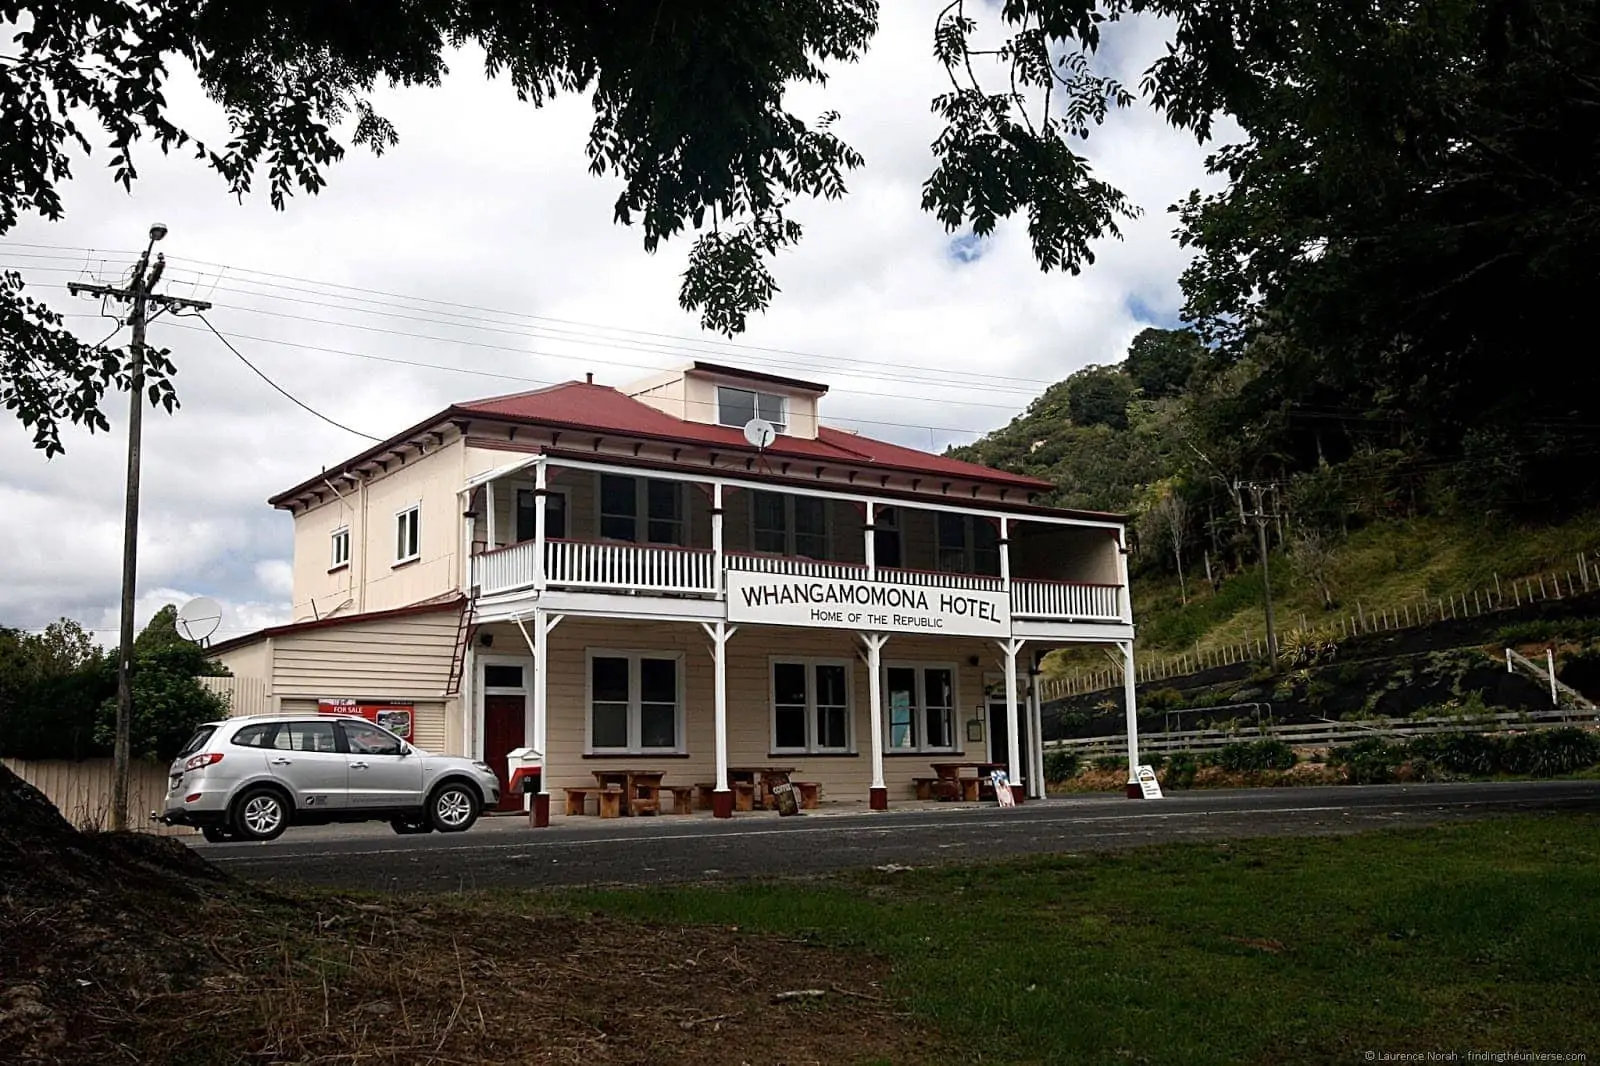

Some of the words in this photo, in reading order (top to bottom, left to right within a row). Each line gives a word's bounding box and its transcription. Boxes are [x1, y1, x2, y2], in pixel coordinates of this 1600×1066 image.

[741, 583, 929, 610] WHANGAMOMONA
[940, 593, 1001, 624] HOTEL
[810, 608, 843, 622] HOME
[848, 613, 862, 623] OF
[867, 614, 888, 625] THE
[893, 614, 943, 628] REPUBLIC
[348, 706, 362, 714] SALE
